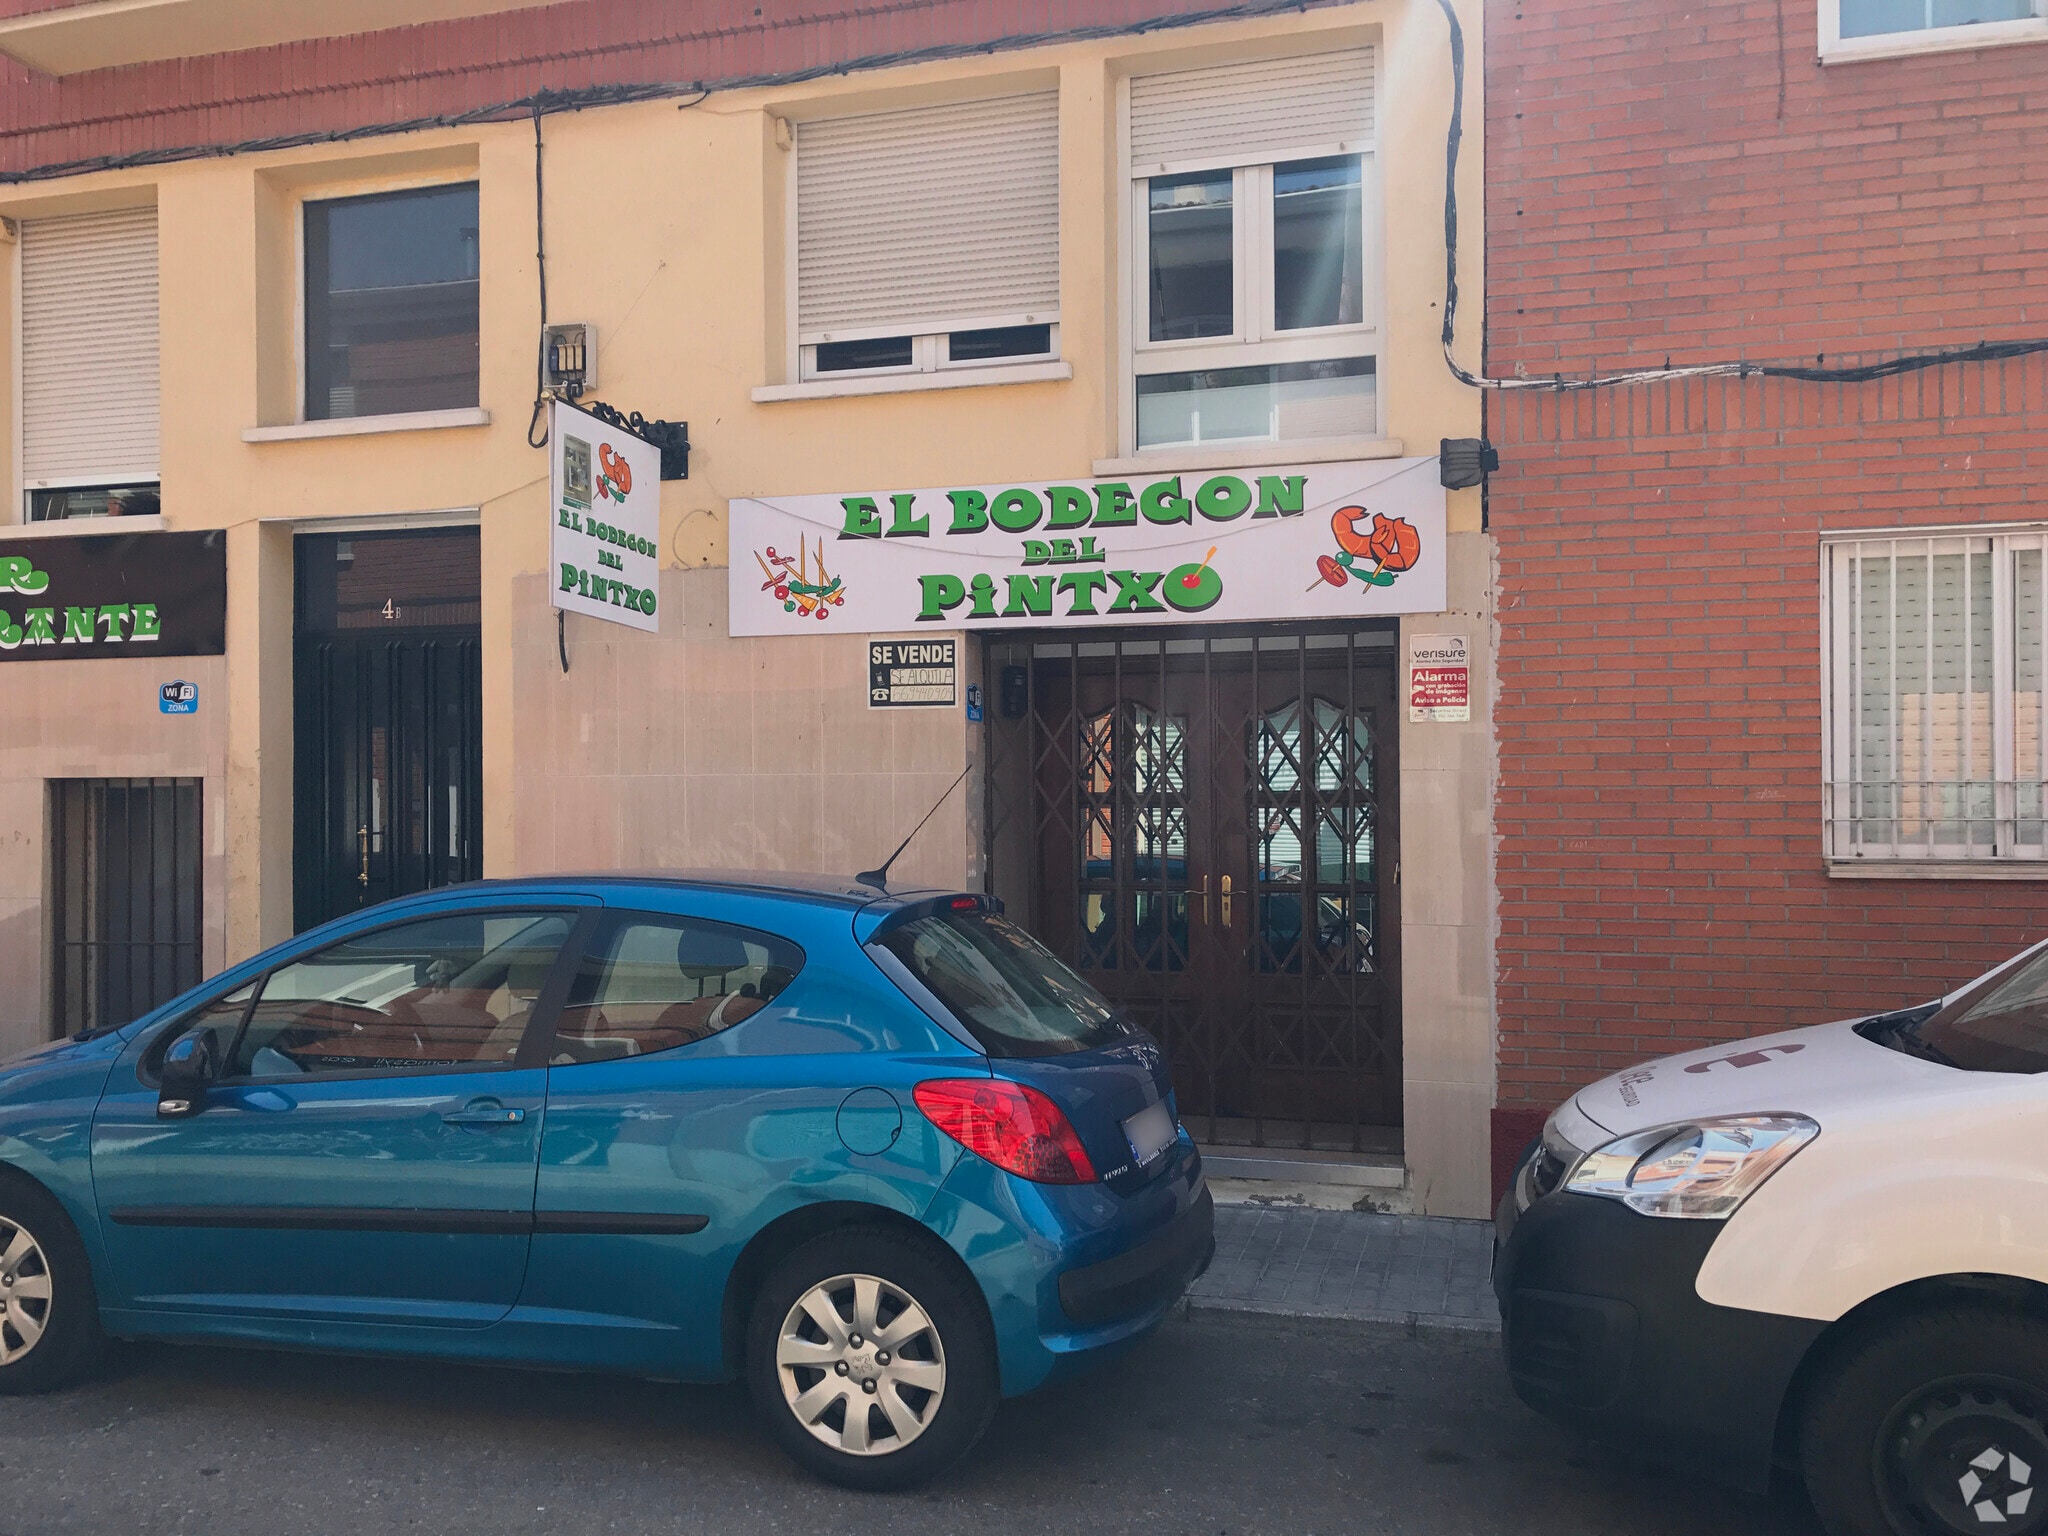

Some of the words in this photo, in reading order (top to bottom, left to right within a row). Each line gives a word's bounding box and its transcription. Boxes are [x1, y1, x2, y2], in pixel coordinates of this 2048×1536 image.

[837, 494, 930, 540] EL
[946, 475, 1309, 537] BODEGON
[558, 508, 583, 533] EL
[586, 517, 657, 559] BODEGON
[597, 549, 624, 571] DEL
[1020, 536, 1106, 567] DEL
[872, 646, 893, 665] SE
[897, 644, 953, 664] VENDE
[1414, 649, 1466, 658] verisure
[1414, 671, 1466, 681] Alarma
[167, 704, 190, 712] ZONA
